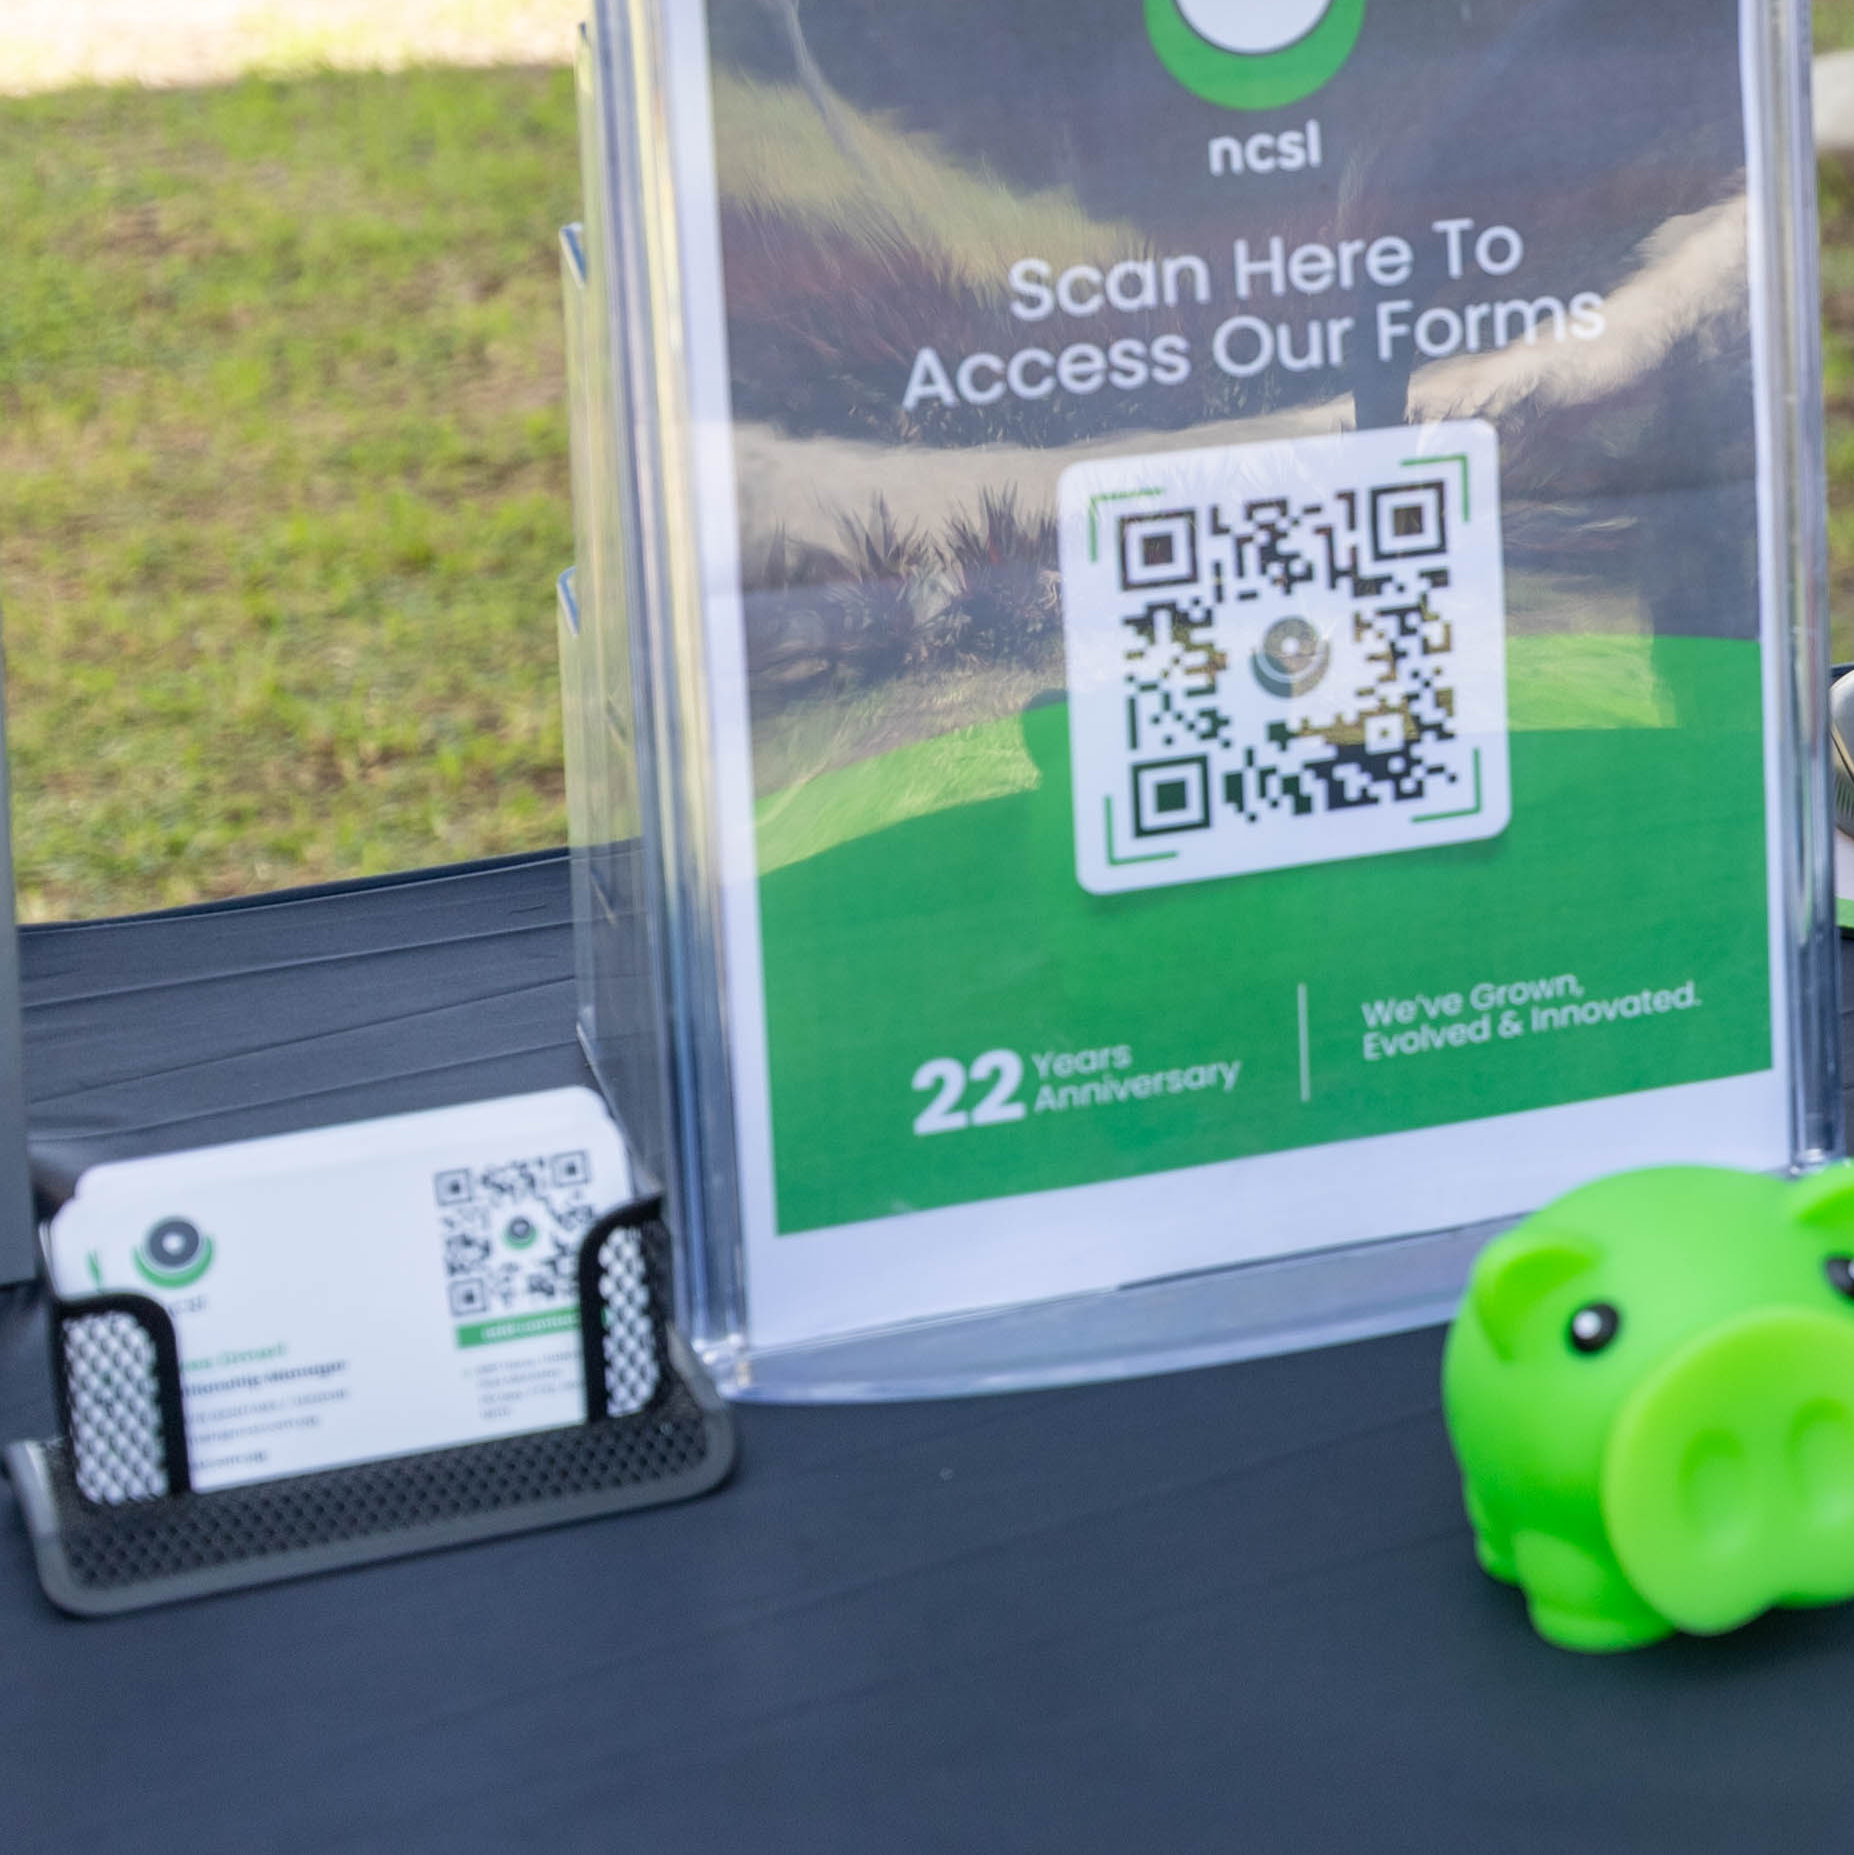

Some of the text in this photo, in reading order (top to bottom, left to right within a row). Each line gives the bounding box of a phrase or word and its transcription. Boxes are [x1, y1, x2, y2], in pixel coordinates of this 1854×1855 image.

[1209, 120, 1323, 176] ncsl
[1008, 217, 1525, 321] Scan Here To
[902, 290, 1606, 411] Access Our Forms
[1361, 973, 1585, 1030] We've Grown,
[1362, 981, 1703, 1061] Evolved & Innovated.
[910, 1042, 1132, 1137] 22 Years
[1032, 1060, 1242, 1116] Anniversary
